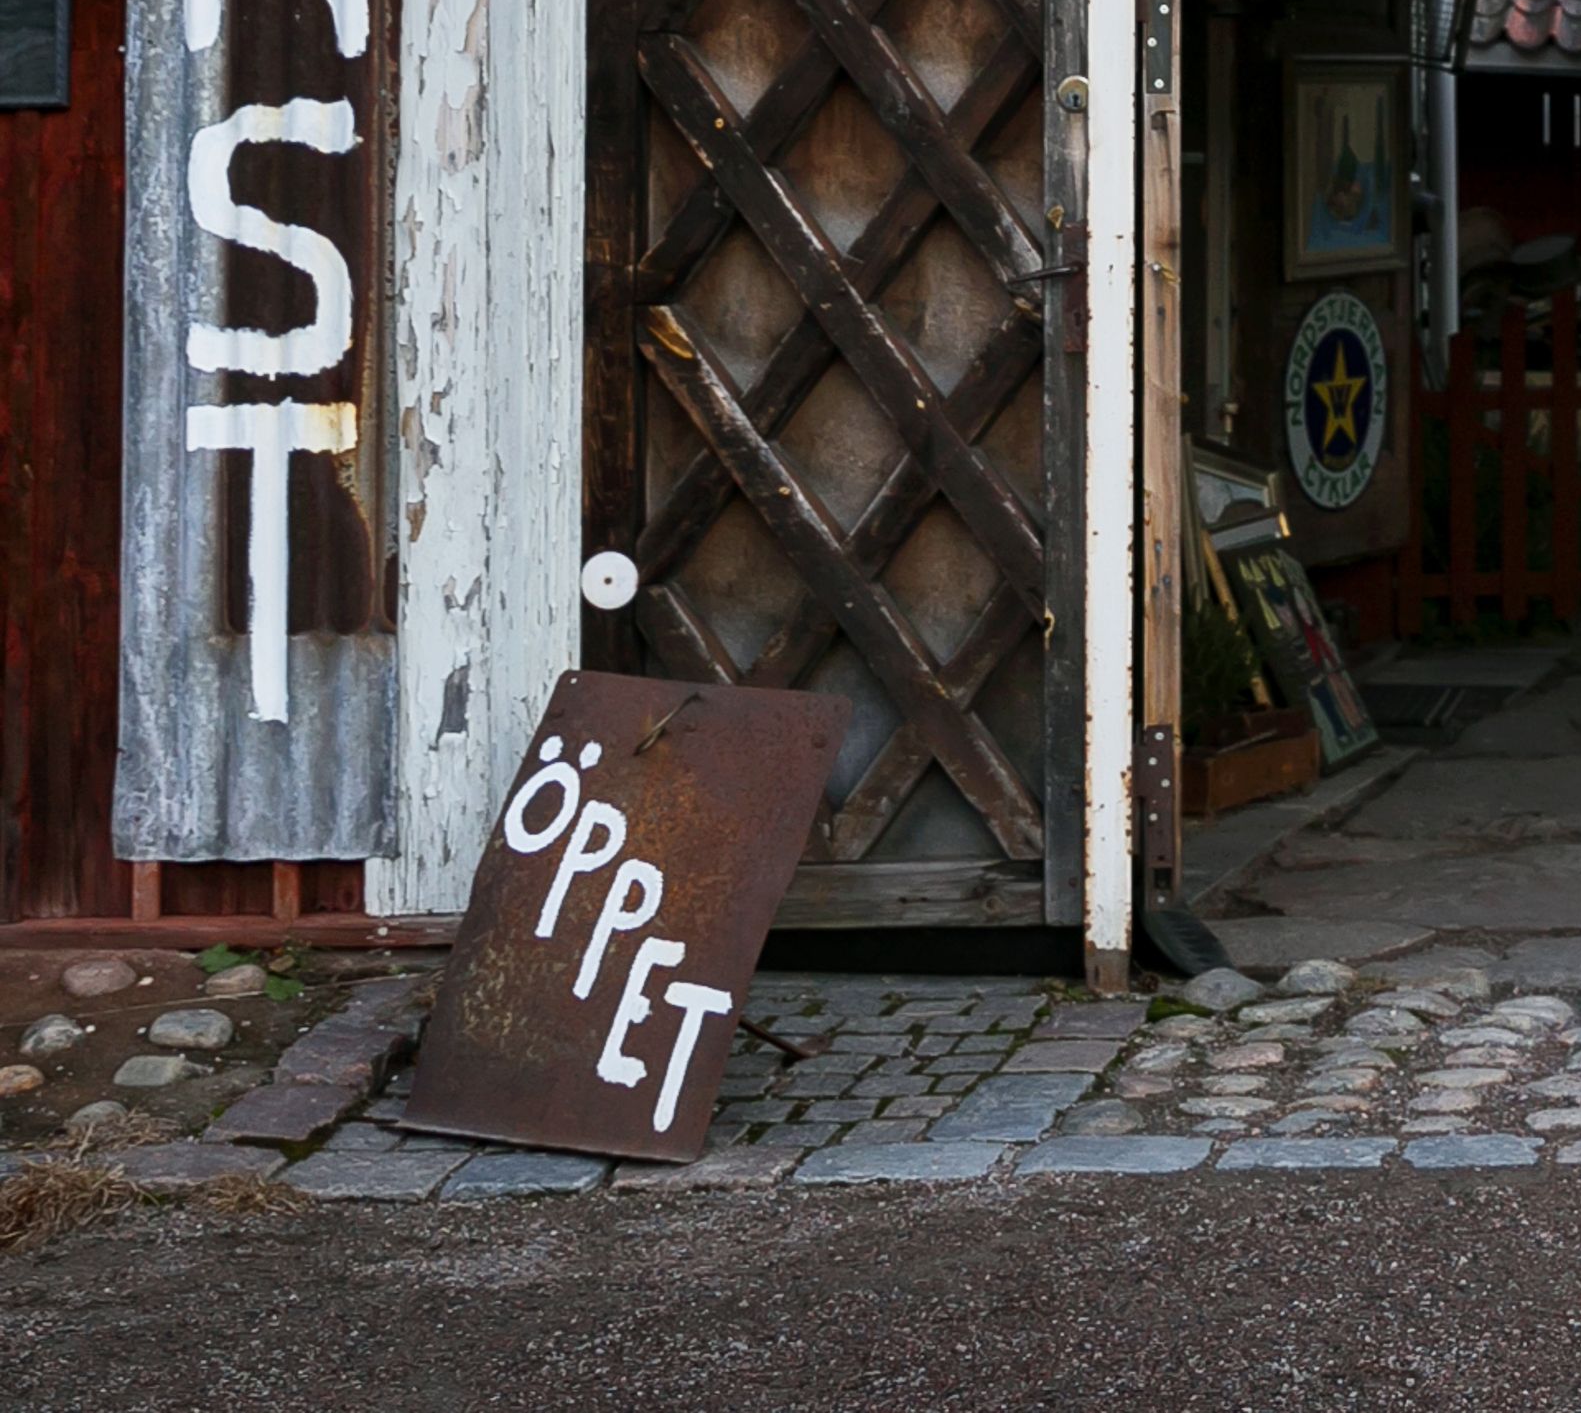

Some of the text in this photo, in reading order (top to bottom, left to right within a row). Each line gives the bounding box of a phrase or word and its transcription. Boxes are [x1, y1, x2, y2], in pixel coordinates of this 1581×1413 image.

[1287, 298, 1386, 426] NORDSTJERNAN
[1303, 452, 1371, 506] CYKLAR
[504, 735, 733, 1132] ÖPPET
